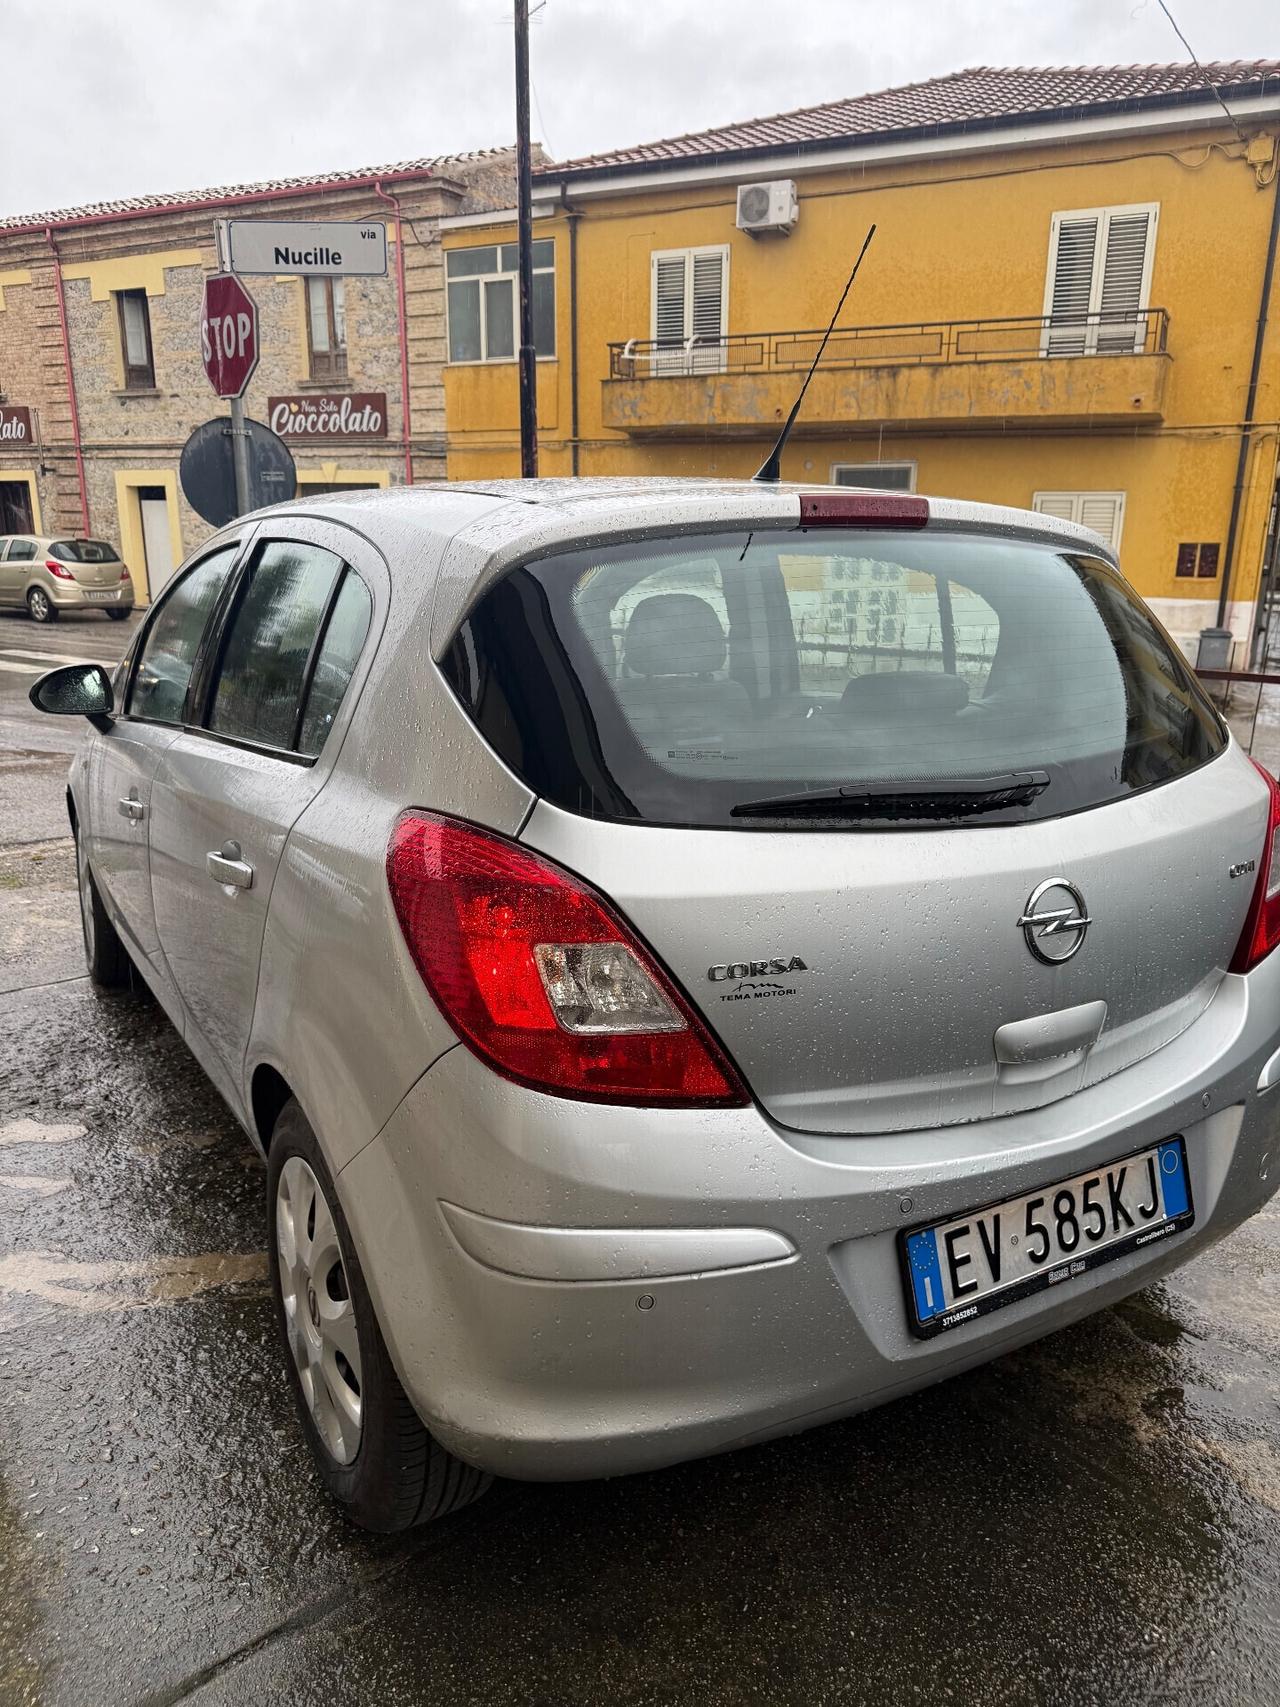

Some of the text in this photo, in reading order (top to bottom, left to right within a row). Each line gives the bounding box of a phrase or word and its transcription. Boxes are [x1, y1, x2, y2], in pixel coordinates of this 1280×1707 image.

[360, 229, 377, 240] via
[274, 247, 342, 265] Nucille
[202, 312, 251, 362] STOP
[271, 397, 381, 436] Cioccolato
[707, 955, 809, 982] CORSA
[719, 988, 797, 1002] TEMA MOTORI
